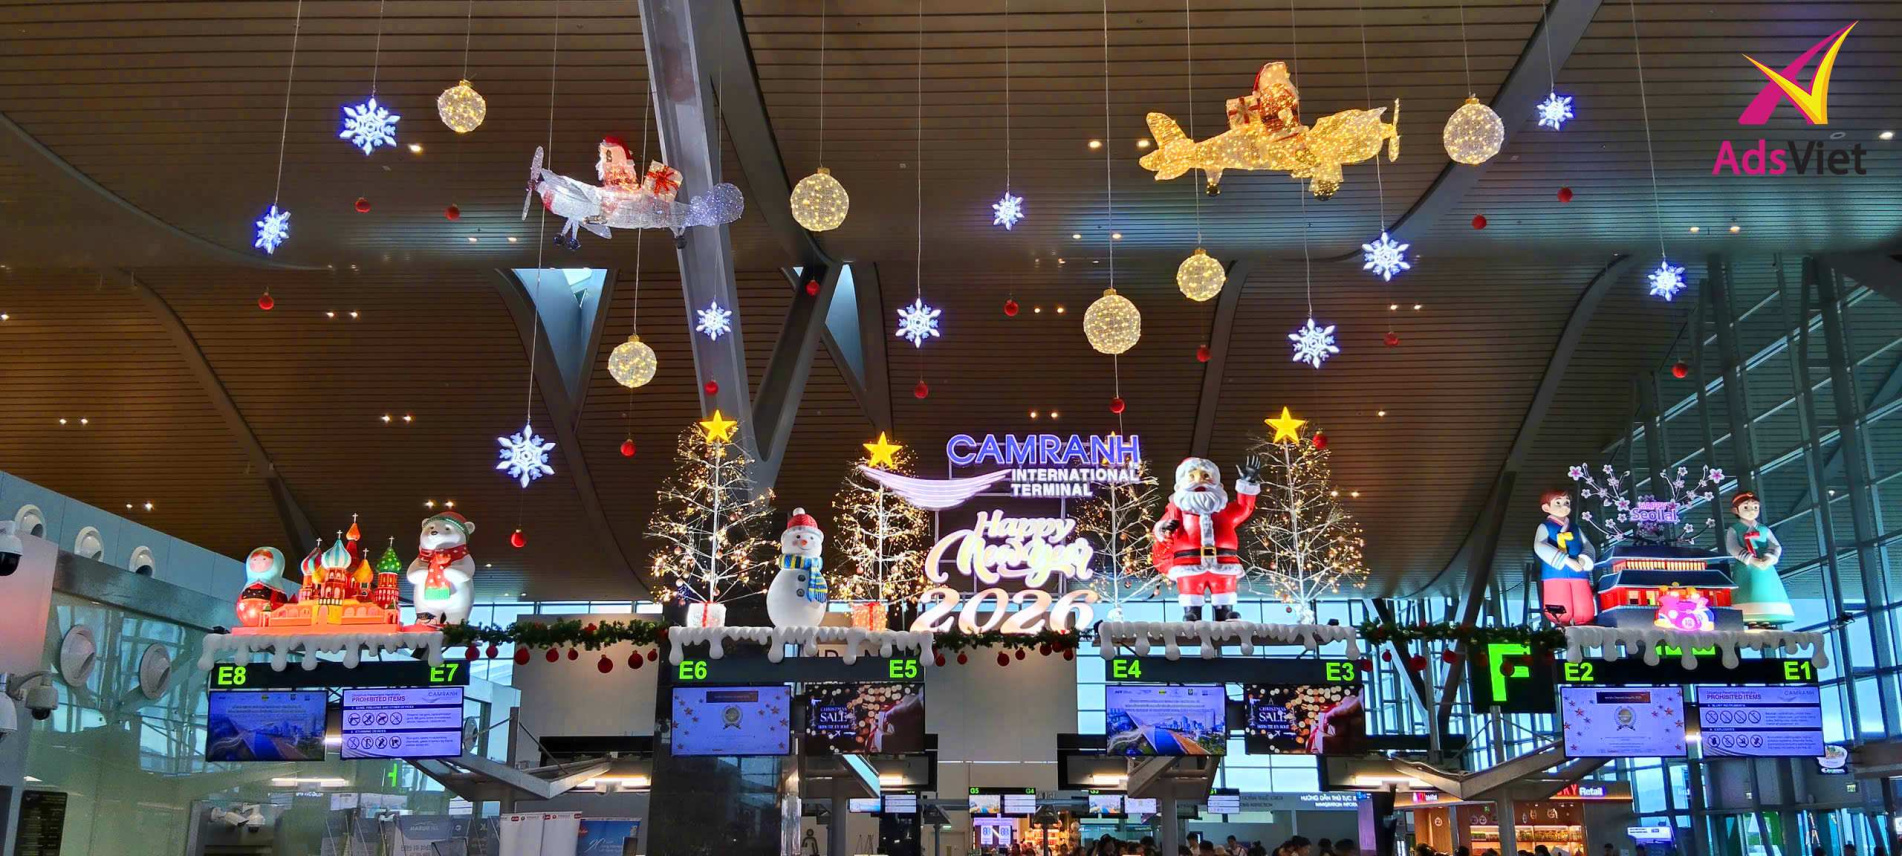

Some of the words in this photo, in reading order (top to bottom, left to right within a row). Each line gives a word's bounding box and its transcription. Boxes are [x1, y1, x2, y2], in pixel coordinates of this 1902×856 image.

[946, 433, 1139, 466] CAMRANH
[1011, 468, 1140, 483] INTERNATIONAL
[1011, 483, 1093, 497] TERMINAL
[1631, 507, 1677, 522] Seollal
[976, 509, 1077, 543] Happy
[925, 529, 1022, 585] New
[910, 587, 1098, 634] 2026
[217, 666, 247, 685] E8
[430, 663, 459, 682] E7
[679, 660, 708, 679] E6
[889, 659, 918, 678] E5
[1113, 659, 1142, 678] E4
[1326, 662, 1355, 681] E3
[1488, 643, 1531, 701] F
[1564, 662, 1594, 681] E2
[1784, 661, 1811, 680] E1
[820, 712, 848, 722] SALE
[1258, 711, 1287, 722] SALE
[1579, 787, 1603, 796] Retail
